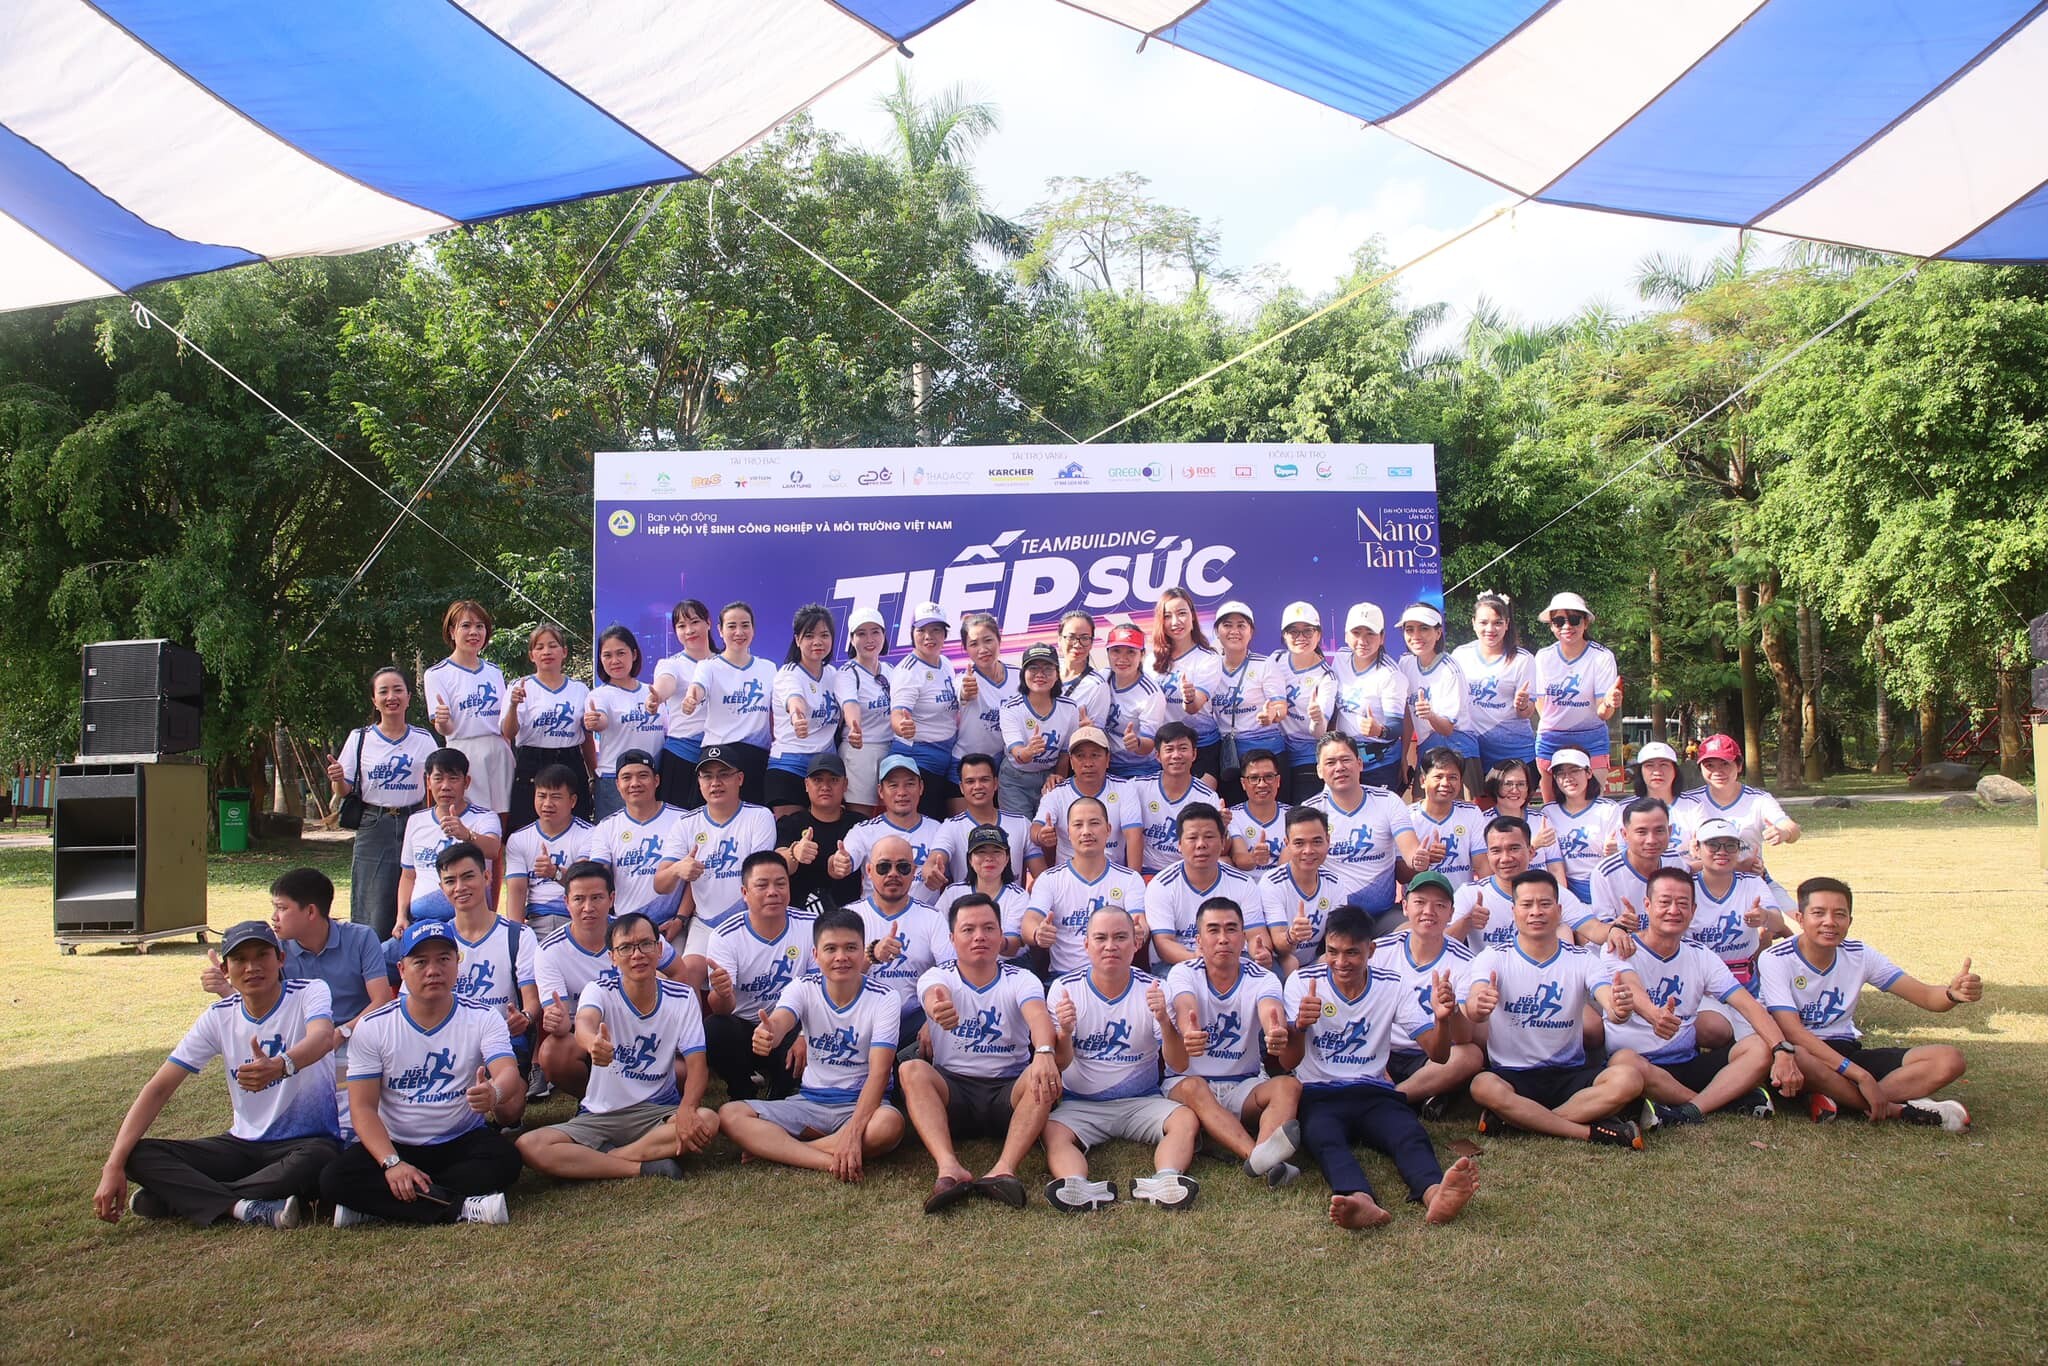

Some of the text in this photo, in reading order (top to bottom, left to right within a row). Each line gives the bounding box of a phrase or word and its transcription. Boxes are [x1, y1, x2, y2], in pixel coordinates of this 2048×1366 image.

[648, 512, 718, 523] Ban vận động
[648, 520, 953, 536] HIỆP HỘI VỆ SINH CÔNG NGHIỆP VÀ MÔI TRƯỜNG VIỆT NAM
[1357, 507, 1437, 558] Nâng
[1021, 529, 1156, 555] TEAMBUILDING
[1359, 542, 1414, 568] Tầm
[833, 529, 1236, 652] TIẾP SỨC
[459, 698, 483, 709] KEEP
[722, 695, 748, 704] KEEP
[1557, 699, 1590, 708] RUNNING
[533, 718, 557, 728] KEEP
[621, 712, 645, 723] KEEP
[367, 770, 392, 780] KEEP
[617, 856, 644, 867] KEEP
[1348, 852, 1386, 863] RUNNING
[1483, 932, 1515, 943] KEEP
[1494, 928, 1513, 936] JUST
[1692, 932, 1723, 943] KEEP
[754, 975, 770, 984] JUST
[879, 970, 918, 978] RUNNING
[741, 981, 770, 991] KEEP
[1516, 996, 1539, 1004] JUST
[1503, 1001, 1540, 1014] KEEP
[1803, 1002, 1821, 1010] JUST
[962, 1017, 980, 1026] JUST
[1529, 1019, 1575, 1029] RUNNING
[821, 1031, 838, 1041] JUST
[951, 1026, 981, 1039] KEEP
[1088, 1033, 1108, 1041] JUST
[1322, 1030, 1345, 1041] JUST
[809, 1036, 840, 1052] KEEP
[1073, 1038, 1109, 1051] KEEP
[1312, 1036, 1347, 1051] KEEP
[401, 1068, 429, 1079] JUST
[388, 1076, 431, 1090] KEEP
